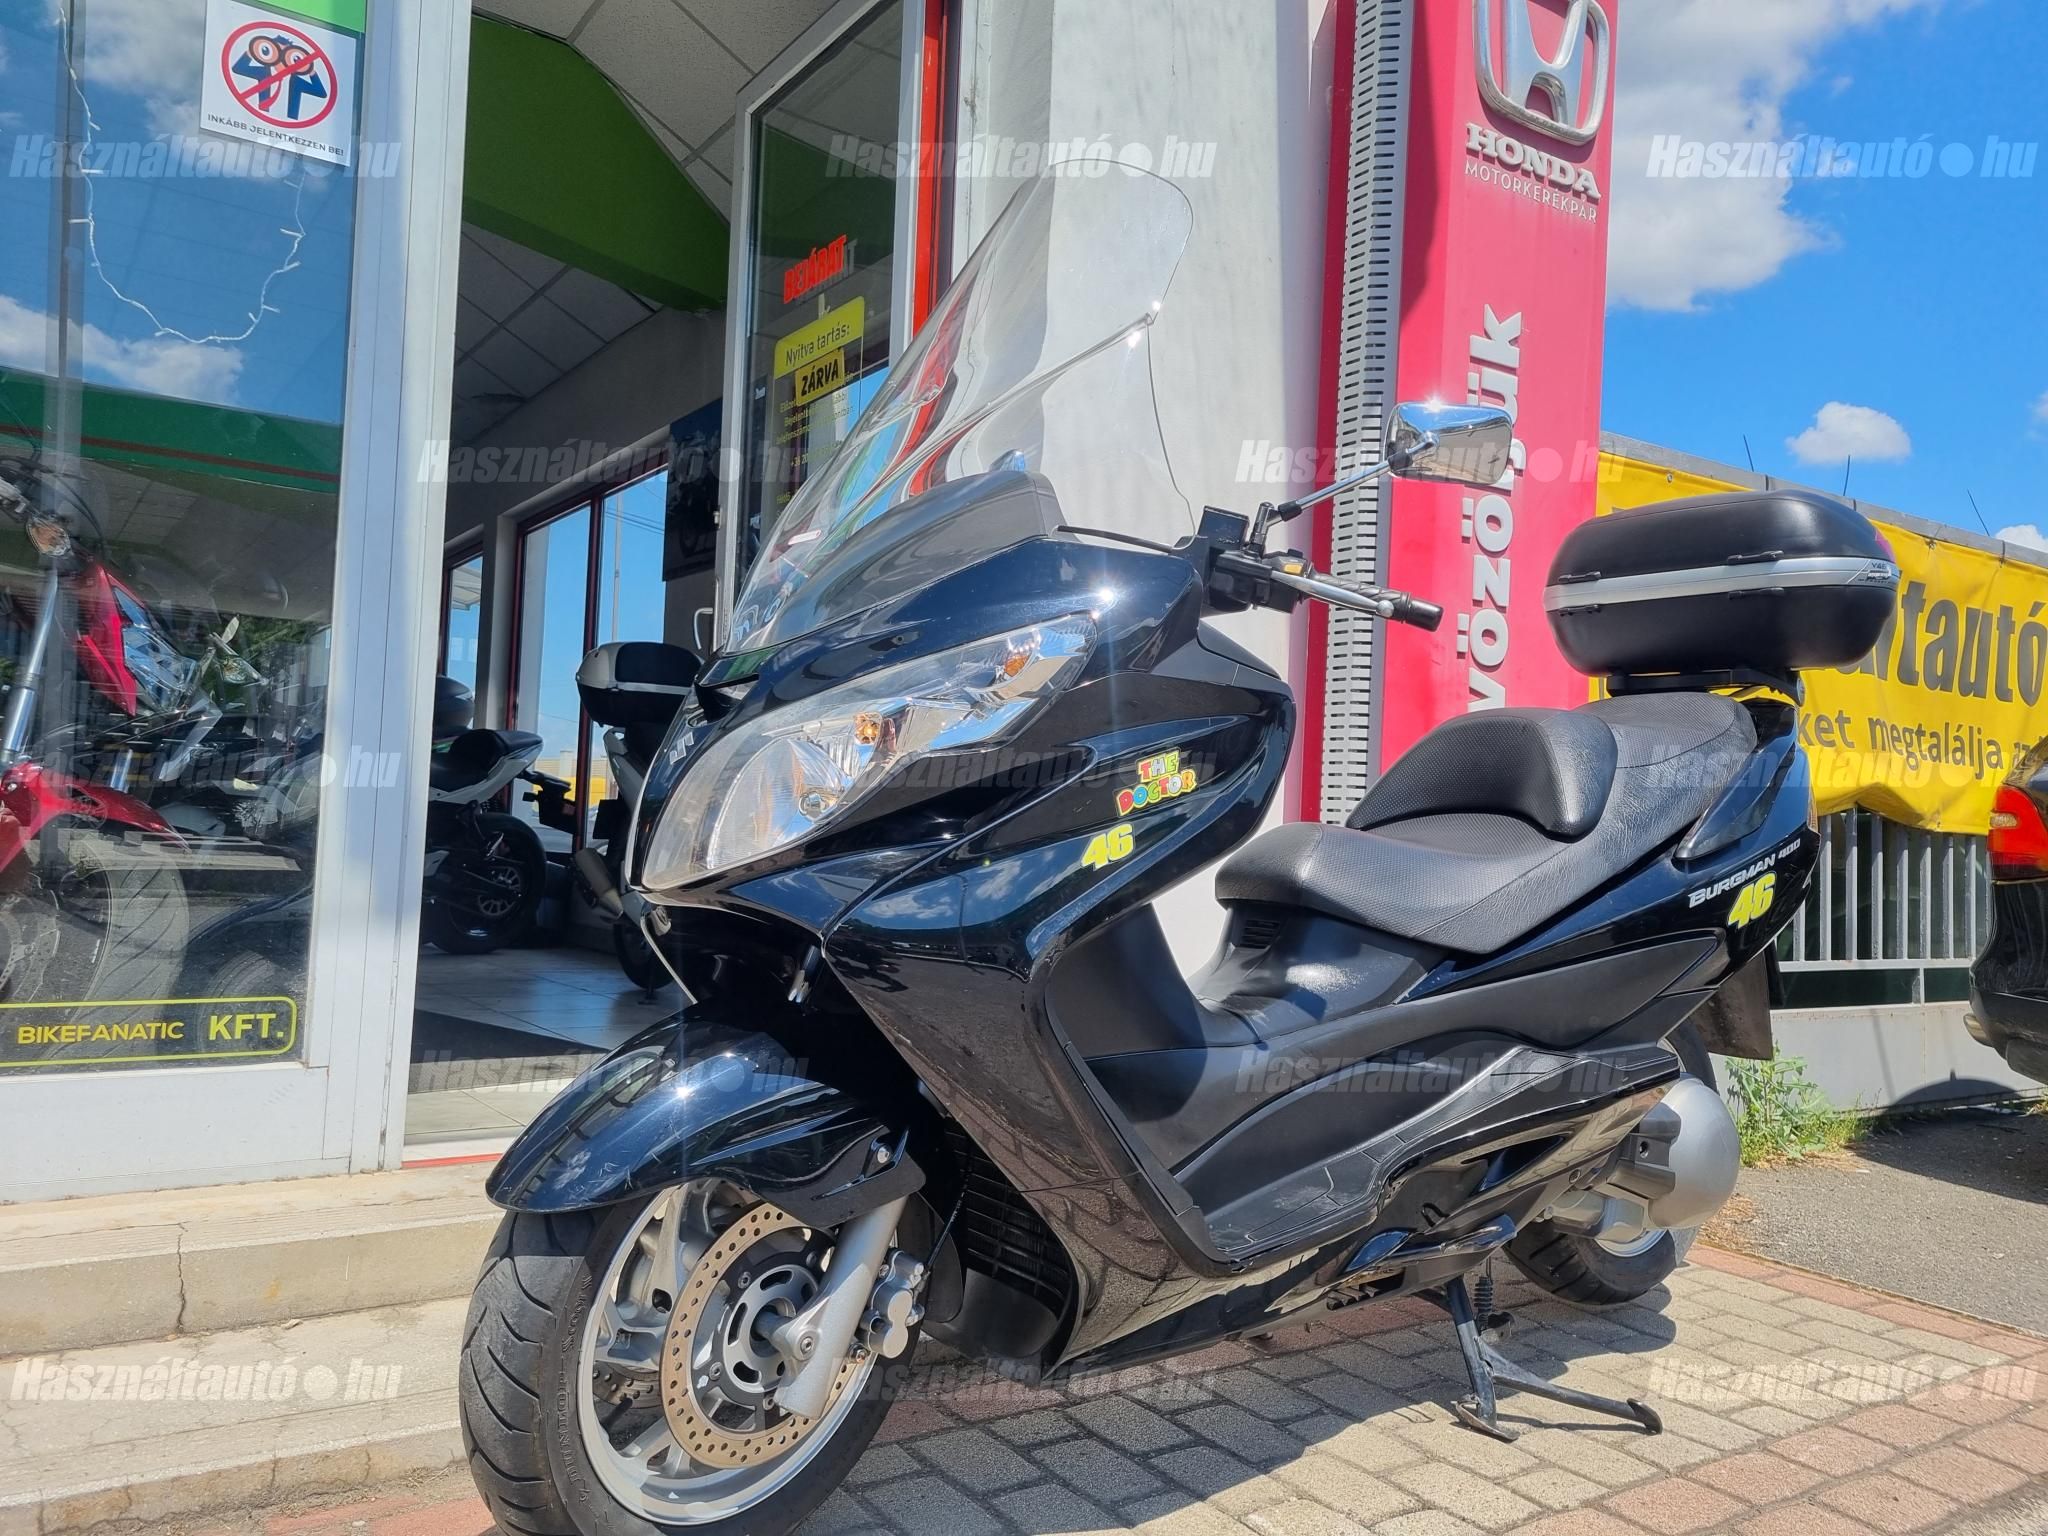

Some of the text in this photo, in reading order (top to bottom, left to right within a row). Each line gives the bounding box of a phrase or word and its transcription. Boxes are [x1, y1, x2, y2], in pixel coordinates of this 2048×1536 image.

[207, 113, 345, 157] INKÁBB JELENTKEZZEN BE!
[1466, 122, 1602, 200] HONDA
[1465, 160, 1598, 224] MOTORKERÉKPÁR
[786, 322, 850, 364] Nyitva tartás:
[801, 358, 839, 396] ZÁRVA
[1137, 750, 1180, 783] THE
[1868, 716, 2004, 780] megtalálja
[1116, 768, 1198, 817] DOCTOR
[1081, 823, 1134, 871] 46
[1688, 838, 1801, 909] BURGMAN 400
[1727, 871, 1777, 929] 46
[17, 1013, 284, 1045] BIKEFANATIC KFT.
